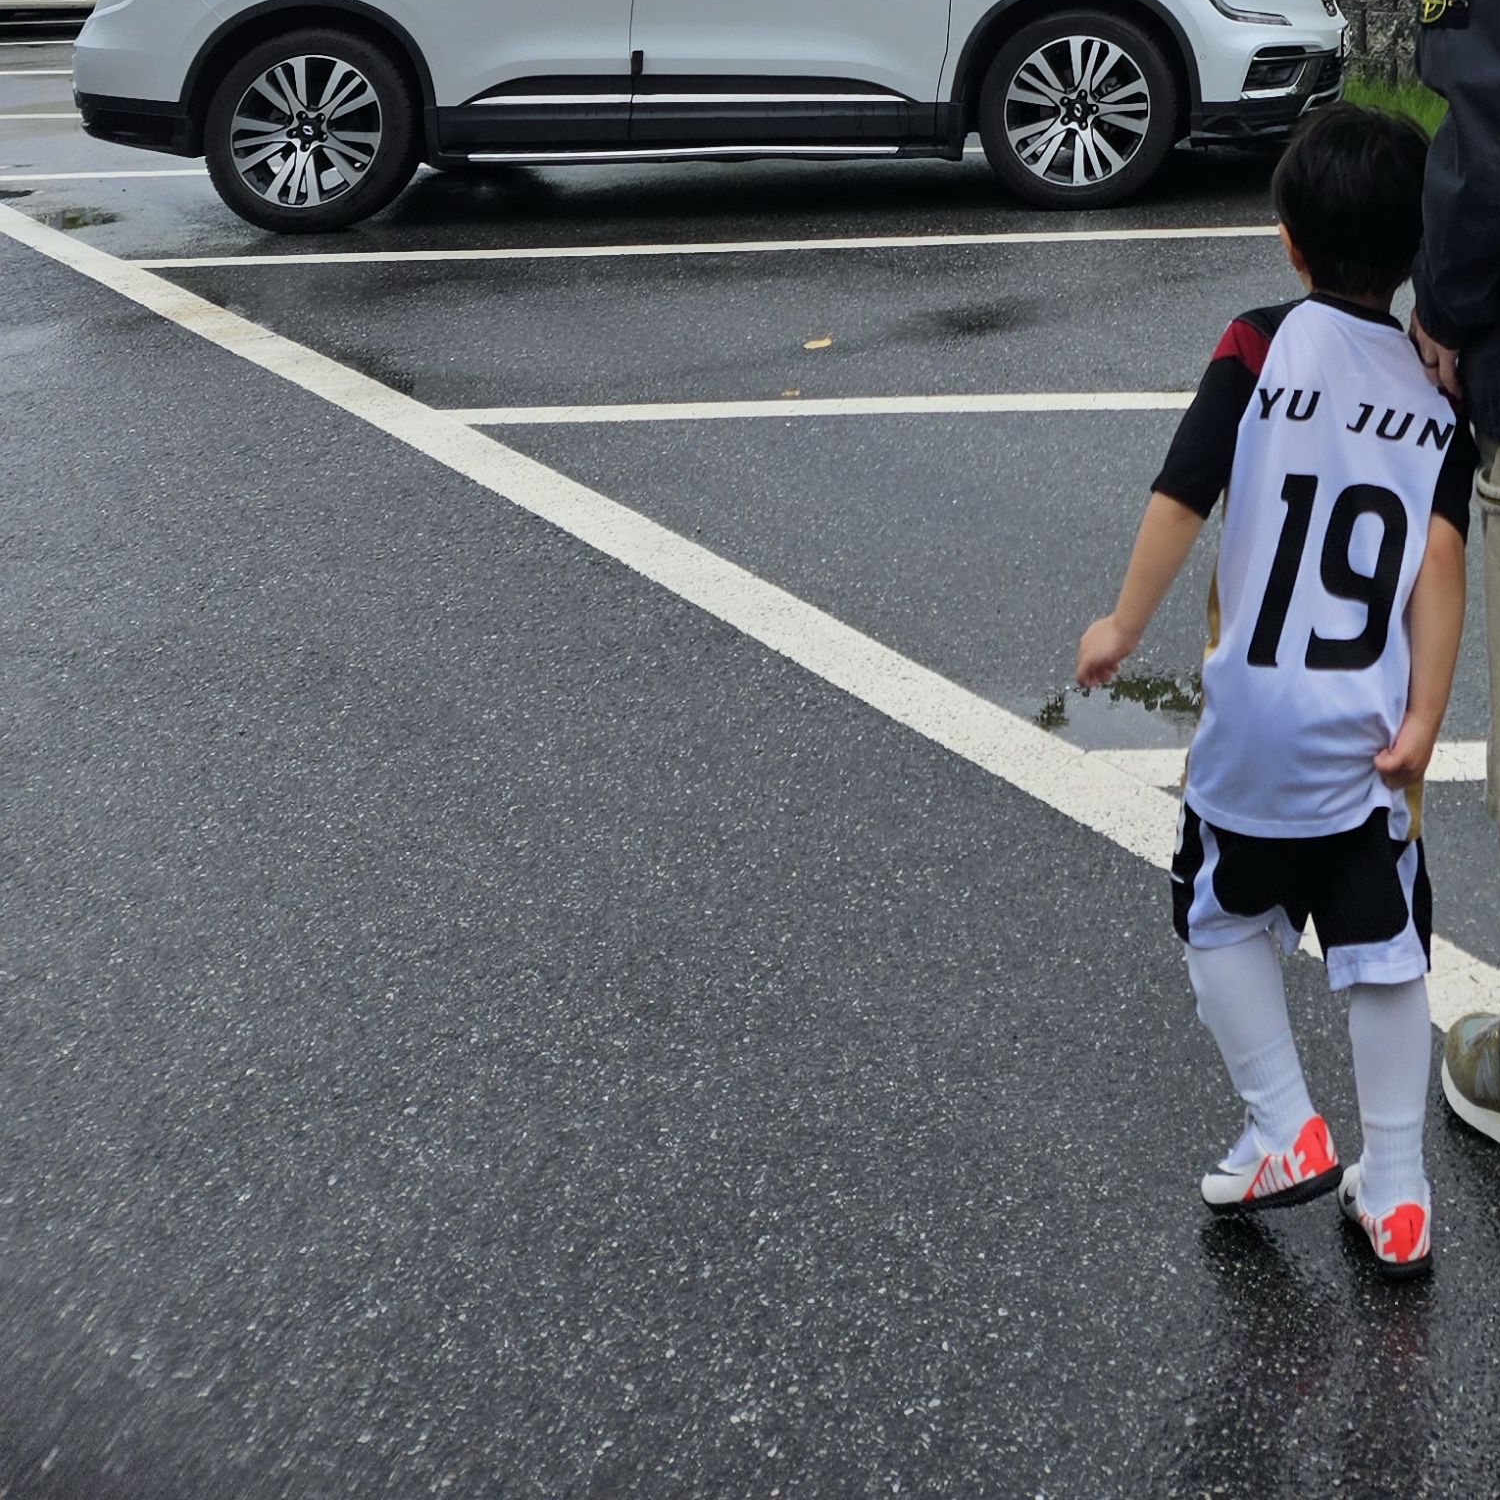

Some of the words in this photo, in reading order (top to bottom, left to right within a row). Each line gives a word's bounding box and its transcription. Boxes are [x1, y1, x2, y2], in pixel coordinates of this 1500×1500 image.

[1258, 387, 1321, 422] YU
[1346, 402, 1456, 452] JUN
[1246, 473, 1408, 671] 19
